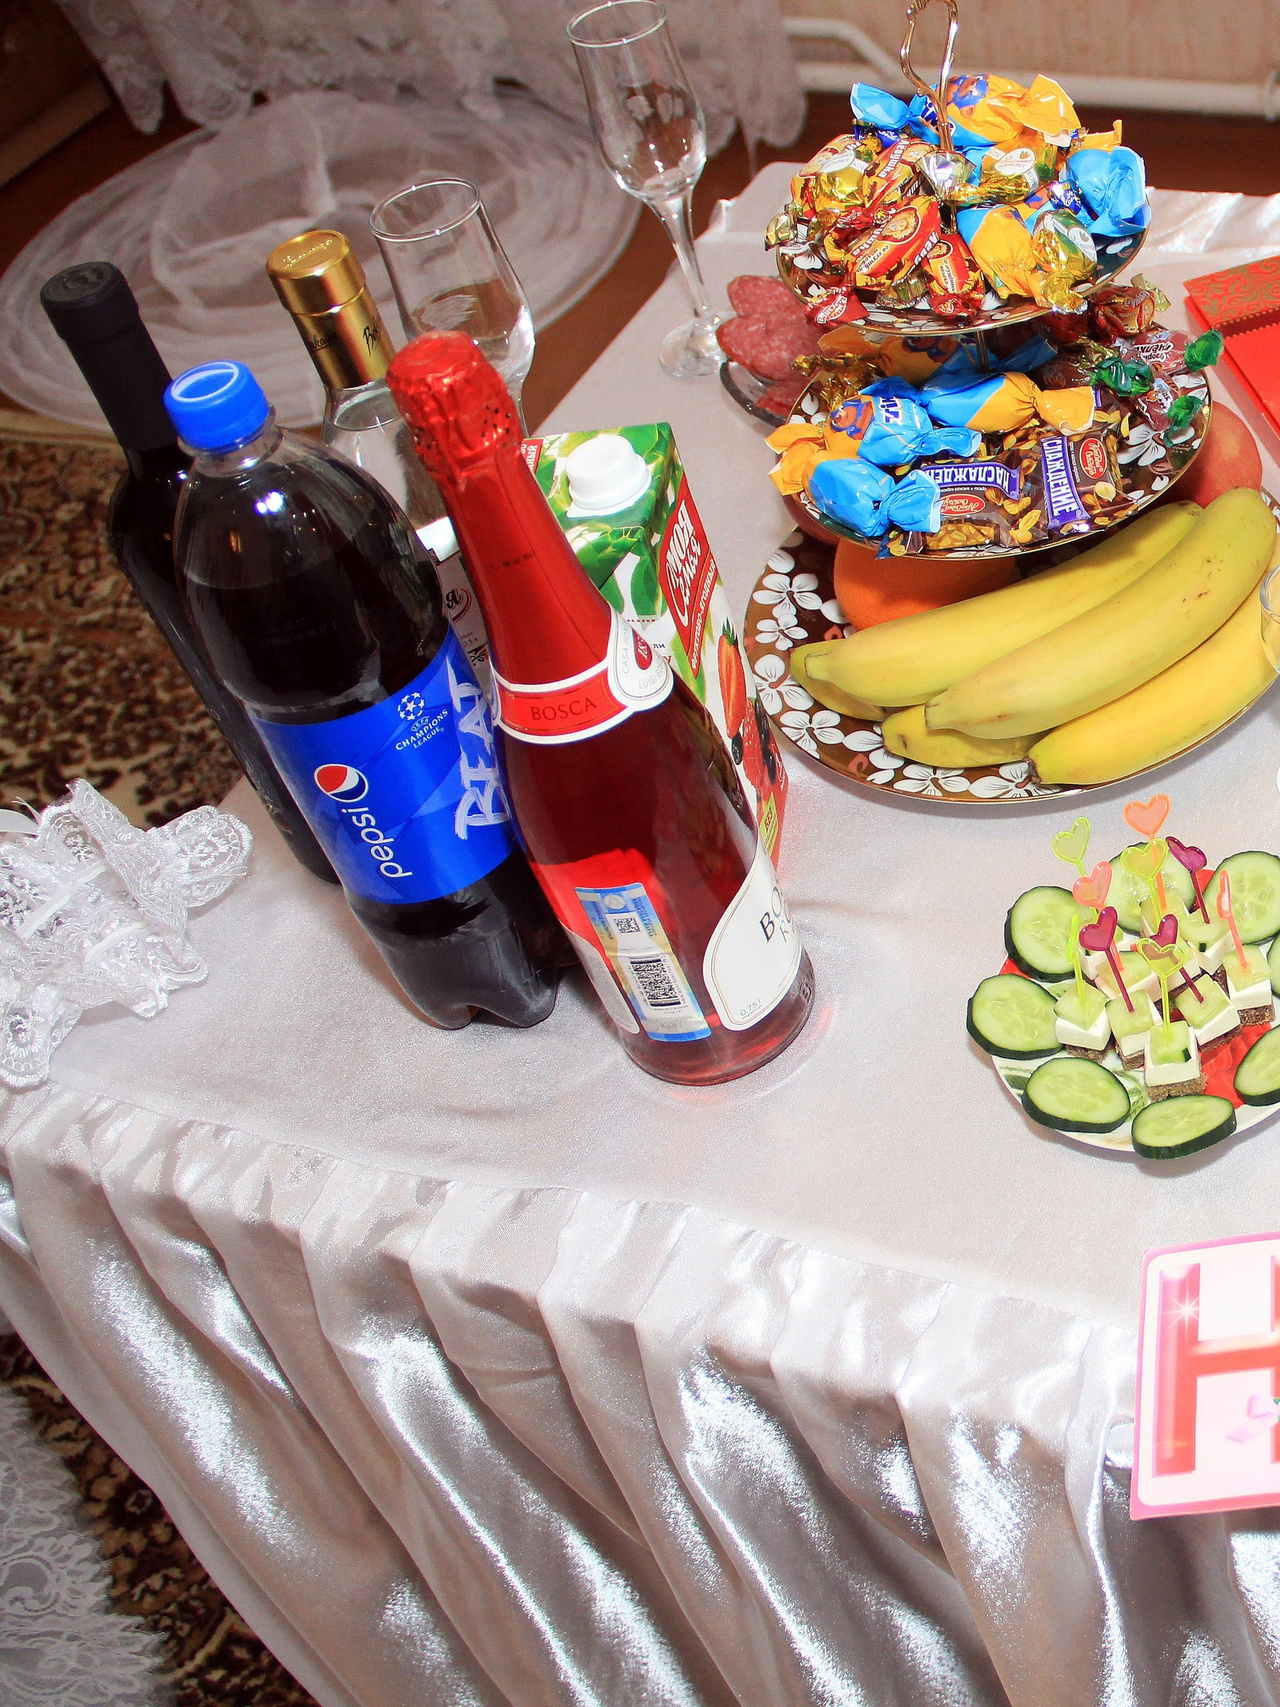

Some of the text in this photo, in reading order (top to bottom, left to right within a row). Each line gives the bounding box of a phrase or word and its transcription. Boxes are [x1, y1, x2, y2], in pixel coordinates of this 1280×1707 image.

[1043, 438, 1079, 517] СЛАЖДЕНИЕ
[666, 499, 695, 580] МОЯ
[666, 535, 702, 628] Семья
[395, 708, 449, 750] CHAMPIONS
[410, 715, 430, 732] UEFA
[413, 727, 441, 749] LEAGUE
[531, 697, 597, 722] BOSCA
[341, 806, 413, 878] pepsi
